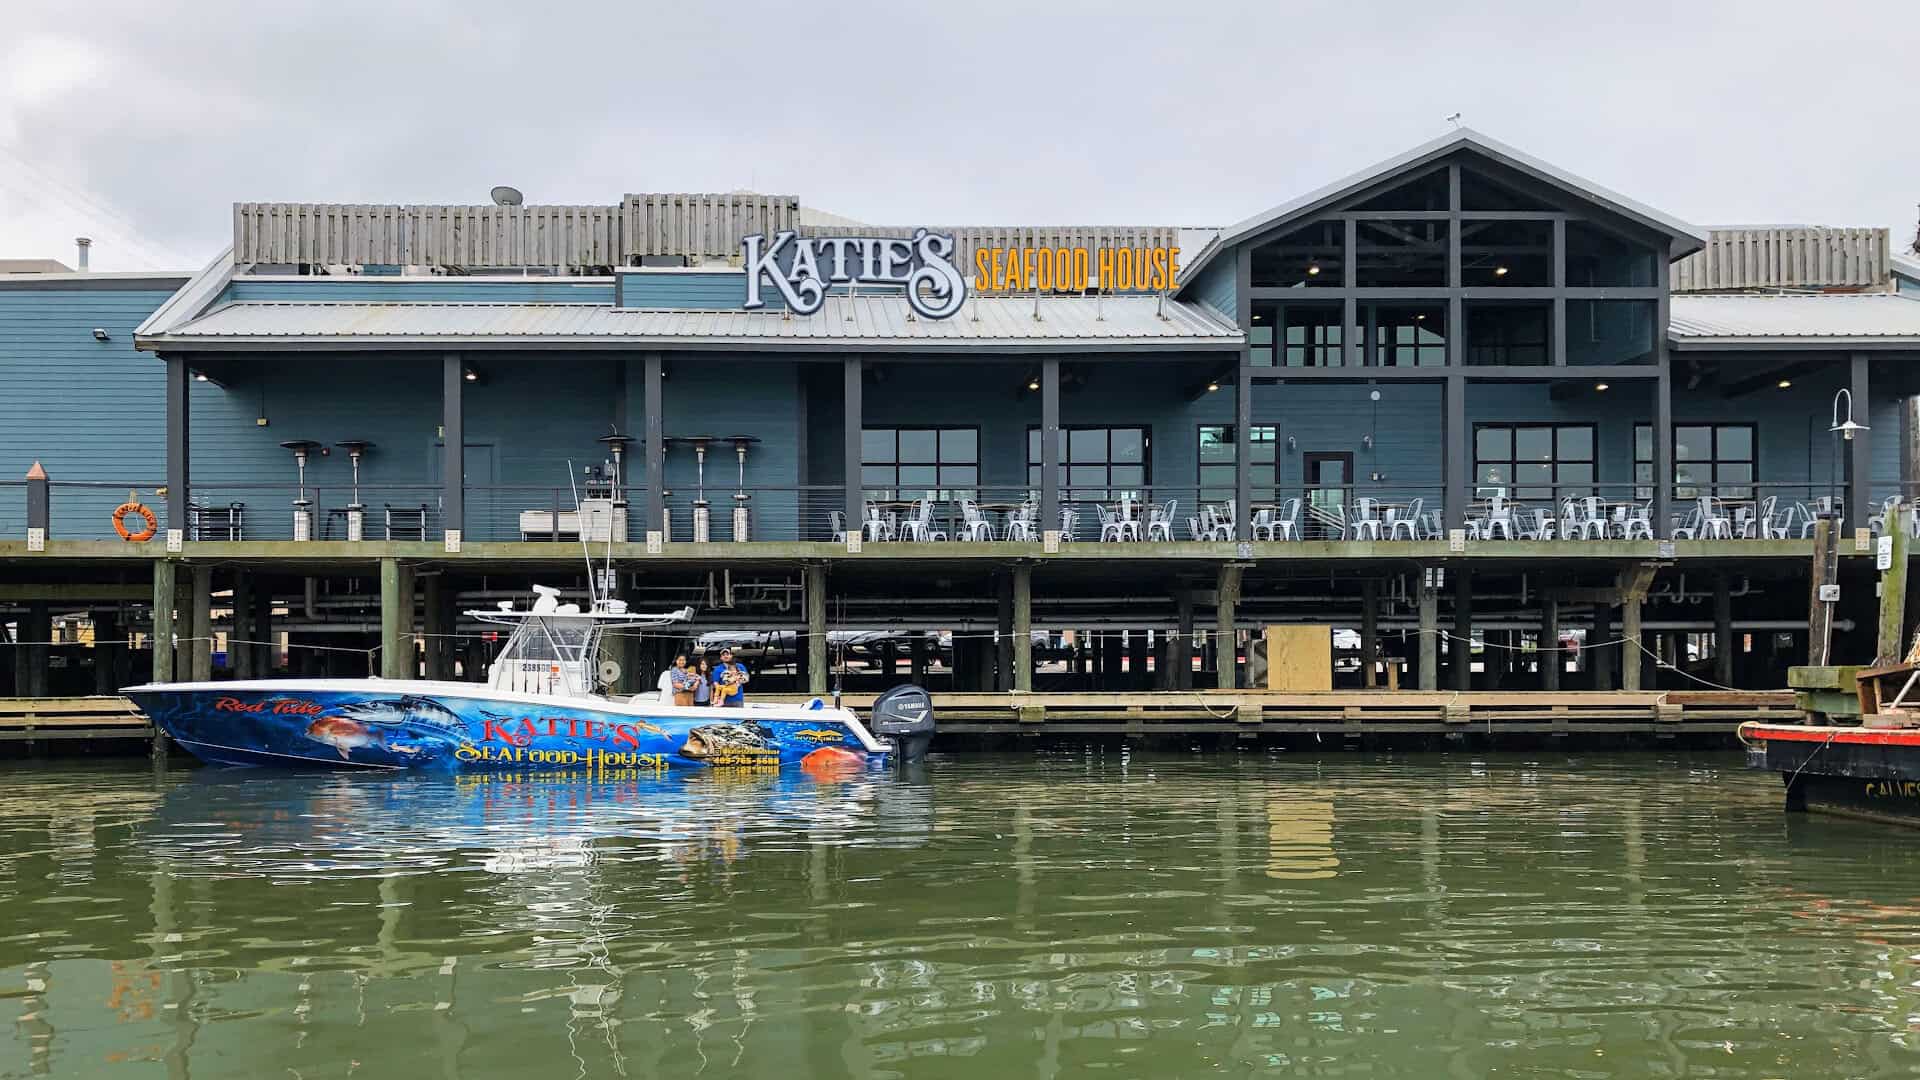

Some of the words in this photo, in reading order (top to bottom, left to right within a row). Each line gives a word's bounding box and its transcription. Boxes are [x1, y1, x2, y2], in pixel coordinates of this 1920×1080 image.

[742, 228, 966, 320] KATIE'S
[975, 247, 1089, 292] SEAFOOD
[1098, 247, 1181, 291] HOUSE
[215, 696, 266, 712] Red
[272, 699, 323, 715] Tide
[480, 716, 640, 750] KATIE'S
[455, 741, 577, 764] SEAFOOD
[578, 747, 670, 769] HOUSE
